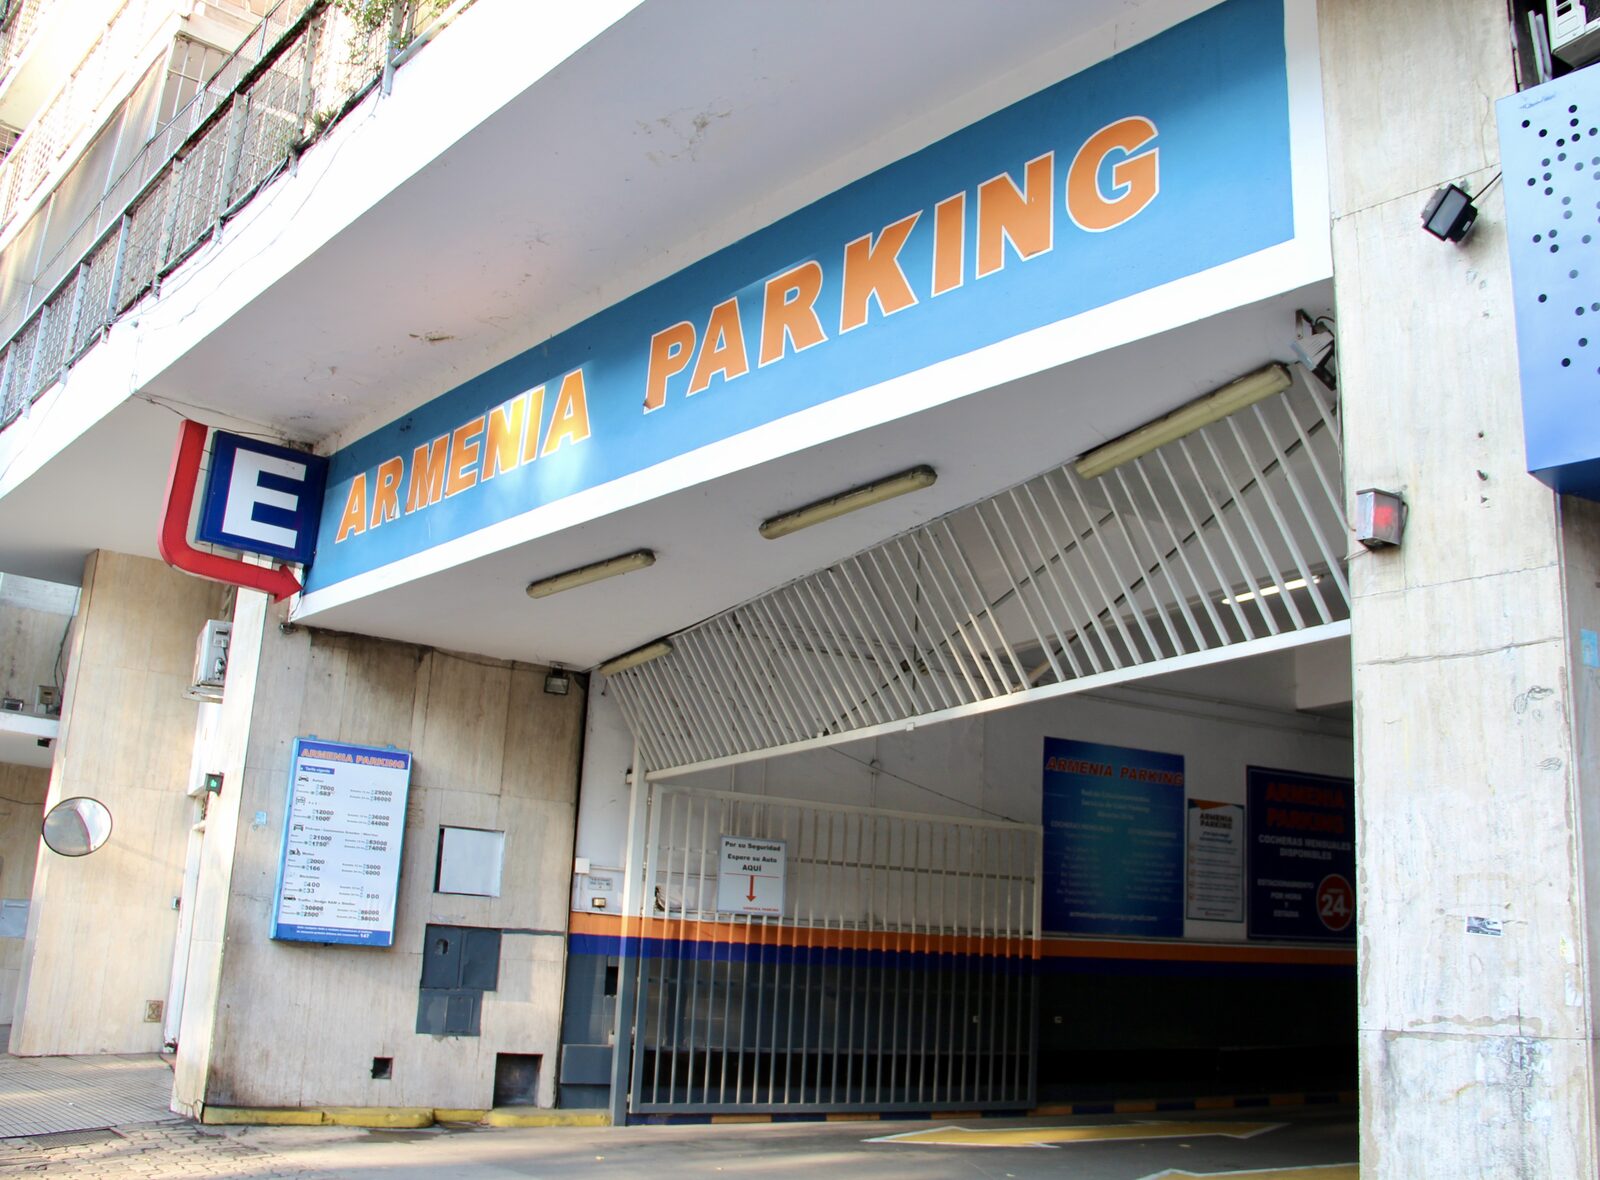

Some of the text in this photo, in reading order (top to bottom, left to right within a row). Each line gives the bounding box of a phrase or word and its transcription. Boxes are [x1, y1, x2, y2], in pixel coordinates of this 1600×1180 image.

[335, 115, 1160, 544] ARMENIA PARKING
[222, 448, 306, 549] E
[301, 748, 405, 769] ARMENIA PARKING
[1046, 757, 1184, 786] ARMENIA PARKING
[1199, 812, 1233, 822] ARMENIA
[1200, 820, 1233, 829] PARKING
[747, 843, 781, 851] Seguridad
[1258, 834, 1352, 851] COCHERAS MENSUALES
[727, 853, 750, 861] Espere
[1279, 847, 1332, 861] DISPONIBLES
[1321, 893, 1349, 917] 24
